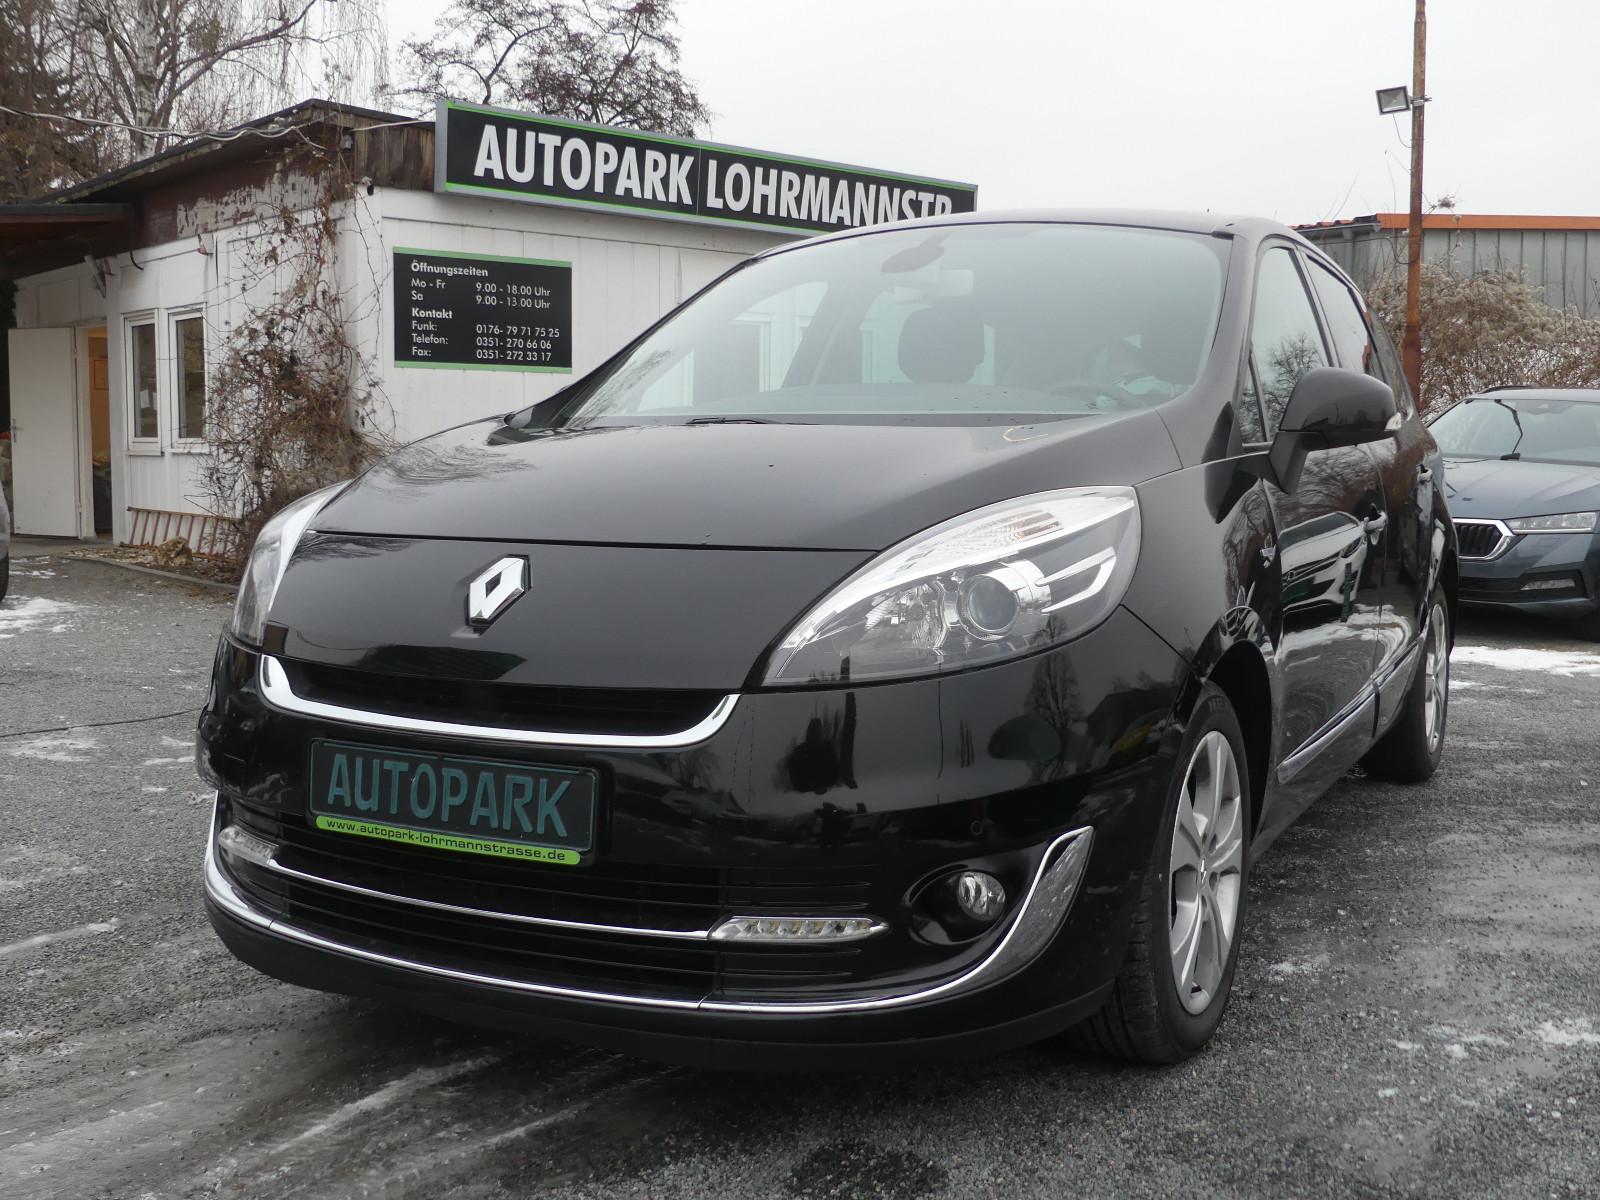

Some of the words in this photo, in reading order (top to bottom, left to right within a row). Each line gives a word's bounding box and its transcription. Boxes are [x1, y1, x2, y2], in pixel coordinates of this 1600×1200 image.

[473, 124, 695, 206] AUTOPARK
[411, 259, 489, 277] Öffnungszeiten
[411, 278, 426, 288] Mo
[436, 279, 446, 289] Fr
[476, 282, 497, 293] 9.00
[506, 284, 532, 295] 18.00
[534, 286, 551, 297] Uhr
[411, 290, 424, 301] Sa
[476, 295, 497, 306] 9.00
[506, 296, 532, 308] 13.00
[534, 298, 551, 309] Uhr
[411, 307, 453, 319] Kontakt
[412, 320, 438, 331] Funk:
[506, 326, 518, 336] 79
[520, 326, 531, 336] 71
[535, 327, 546, 337] 75
[548, 328, 560, 338] 25
[411, 333, 449, 345] Telefon:
[506, 338, 524, 348] 270
[526, 339, 538, 349] 66
[540, 340, 552, 350] 06
[412, 346, 432, 357] Fax:
[506, 350, 524, 360] 272
[526, 351, 538, 361] 33
[541, 352, 552, 362] 17
[327, 753, 571, 838] AUTOPARK
[326, 819, 566, 861] www.autopark-lohrmannstrasse.de
